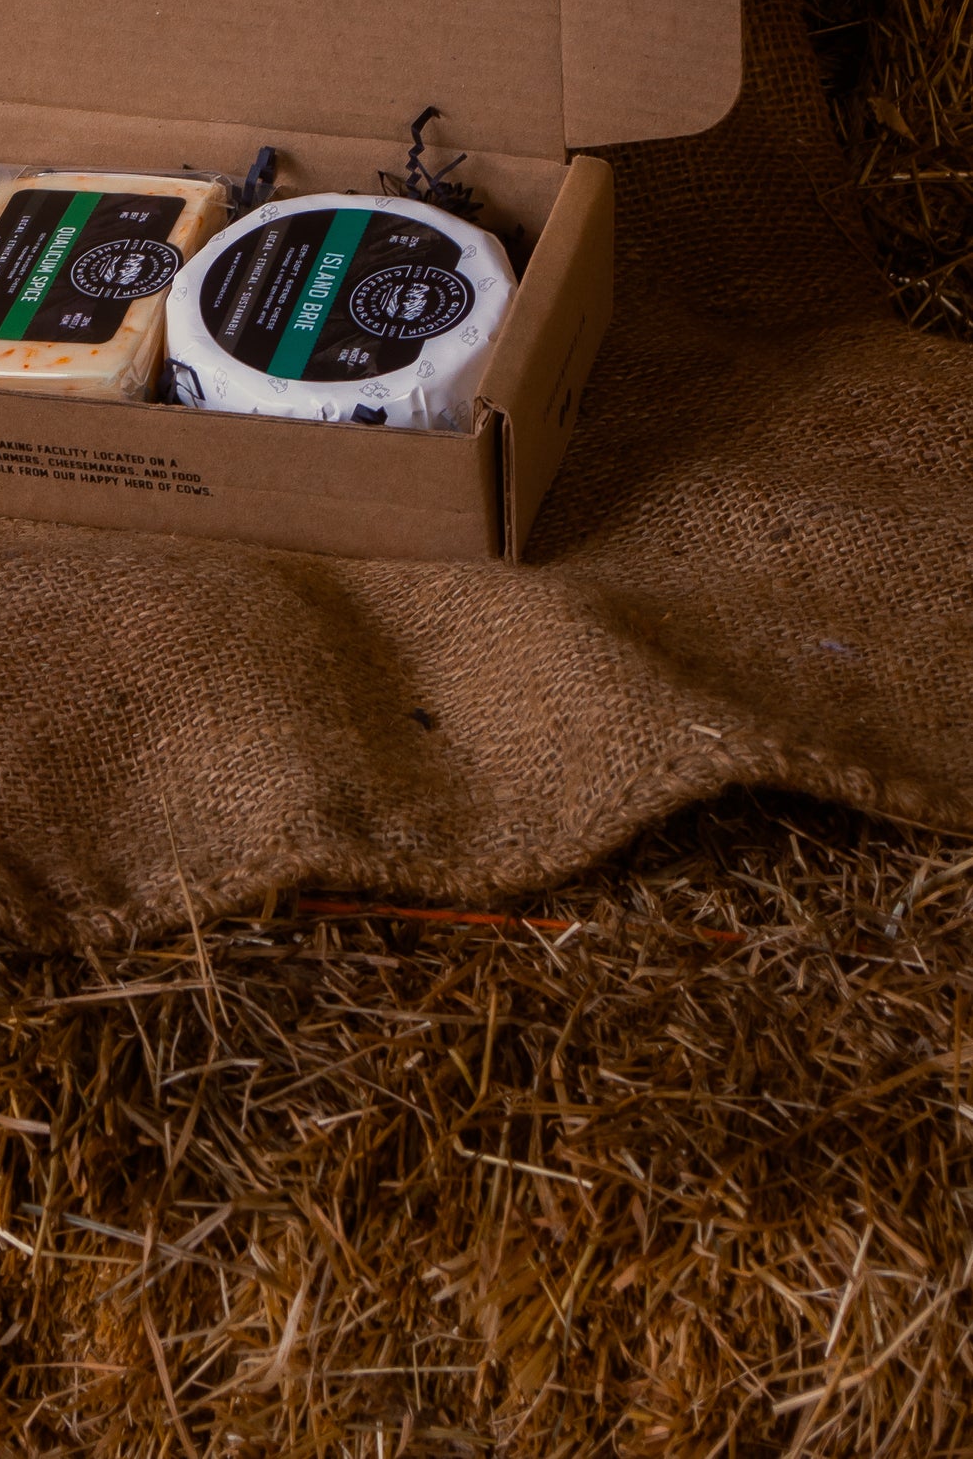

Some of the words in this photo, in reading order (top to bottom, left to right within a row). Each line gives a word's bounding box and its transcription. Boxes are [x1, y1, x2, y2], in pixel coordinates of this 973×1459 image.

[12, 215, 31, 233] LOCAL
[35, 226, 76, 272] QUALICUM
[146, 244, 171, 263] LITTLE
[261, 230, 279, 251] LOCAL
[75, 244, 120, 291] CHEESEWORKS
[246, 258, 267, 284] ETHICAL
[288, 243, 310, 276] SEMI-SOFT
[19, 275, 49, 301] SPICE
[121, 266, 171, 295] QUALICUM
[305, 252, 345, 298] ISLAND
[431, 271, 458, 295] LITTLE
[276, 279, 294, 304] RIPENED
[355, 270, 401, 328] CHEESEWORKS
[224, 292, 252, 335] SUSTAINABLE
[264, 306, 283, 330] CHEESE
[292, 302, 323, 331] BRIE
[406, 301, 460, 334] QUALICUM
[37, 444, 87, 458] FACILITY
[93, 450, 144, 464] LOCATED
[149, 457, 164, 466] ON
[169, 459, 177, 468] A
[19, 466, 48, 478] FROM
[53, 470, 74, 481] OUR
[80, 473, 118, 485] HAPPY
[124, 478, 153, 489] HERD
[158, 482, 171, 492] OF
[176, 484, 213, 497] COWS.
[144, 468, 166, 479] AND
[171, 472, 200, 482] FOOD
